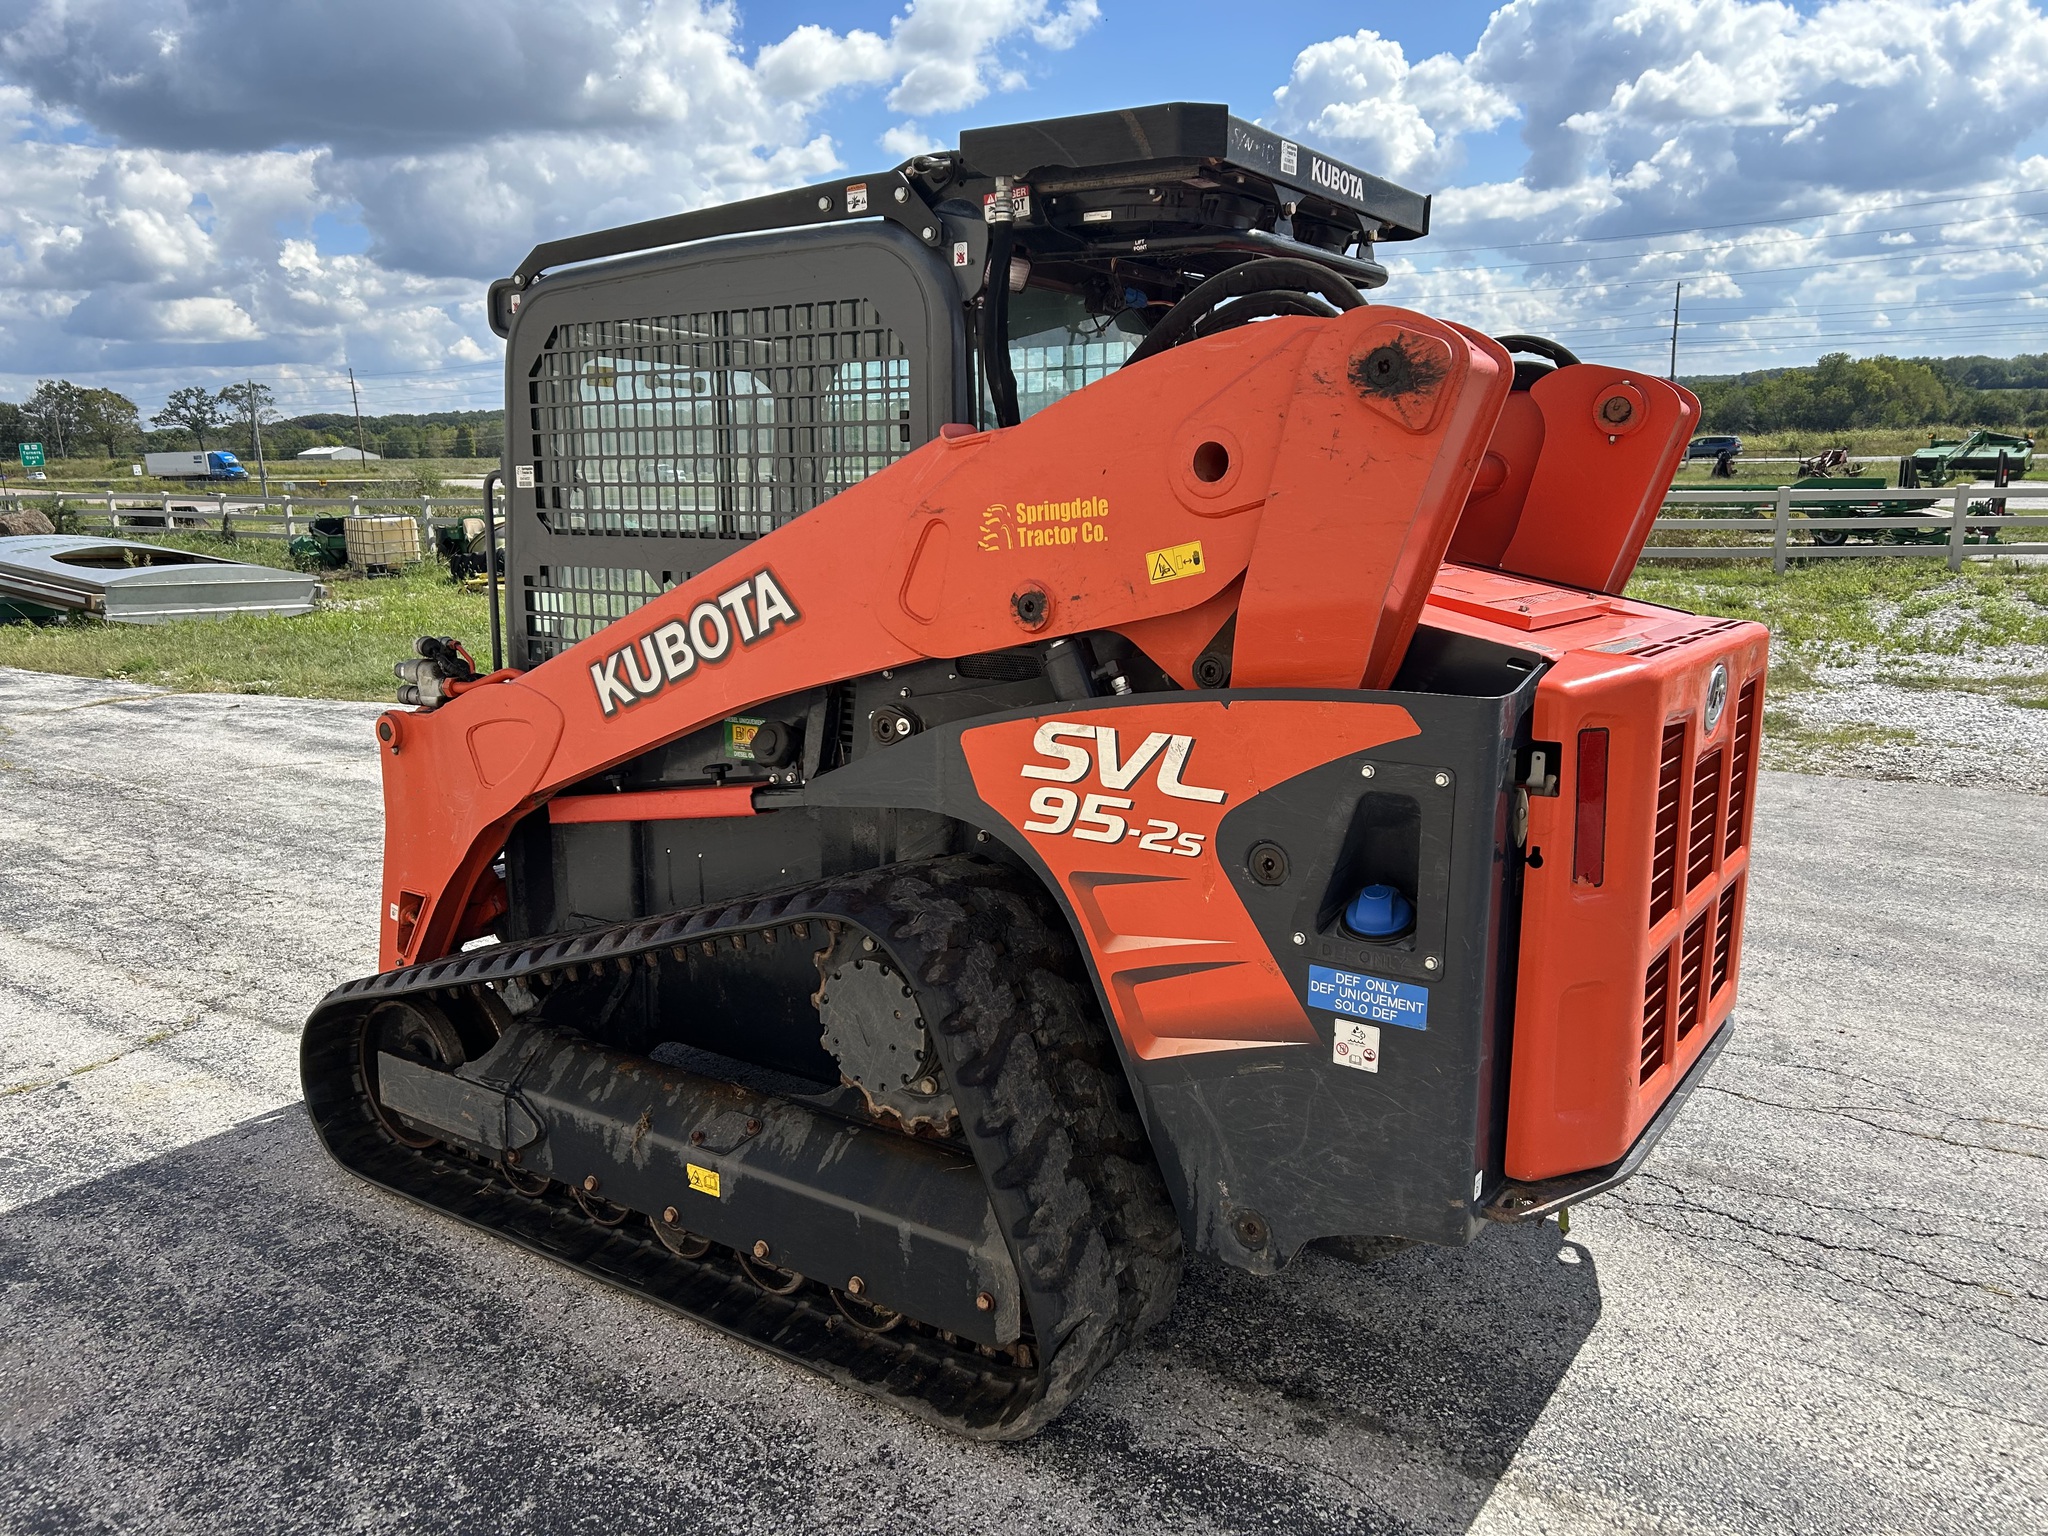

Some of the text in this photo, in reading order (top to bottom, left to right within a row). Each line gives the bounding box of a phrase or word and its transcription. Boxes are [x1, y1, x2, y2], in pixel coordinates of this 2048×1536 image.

[1311, 156, 1364, 202] KUBOTA
[1134, 238, 1145, 246] LIFT
[1016, 496, 1109, 524] Springdale
[1016, 521, 1109, 548] Tractor Co.
[590, 570, 796, 715] KUBOTA
[1020, 721, 1228, 804] SVL
[1359, 950, 1409, 970] ONLY
[1310, 980, 1425, 1014] DEF UNIQUEMENT
[1335, 973, 1400, 995] DEF ONLY
[1334, 998, 1399, 1021] SOLO DEF
